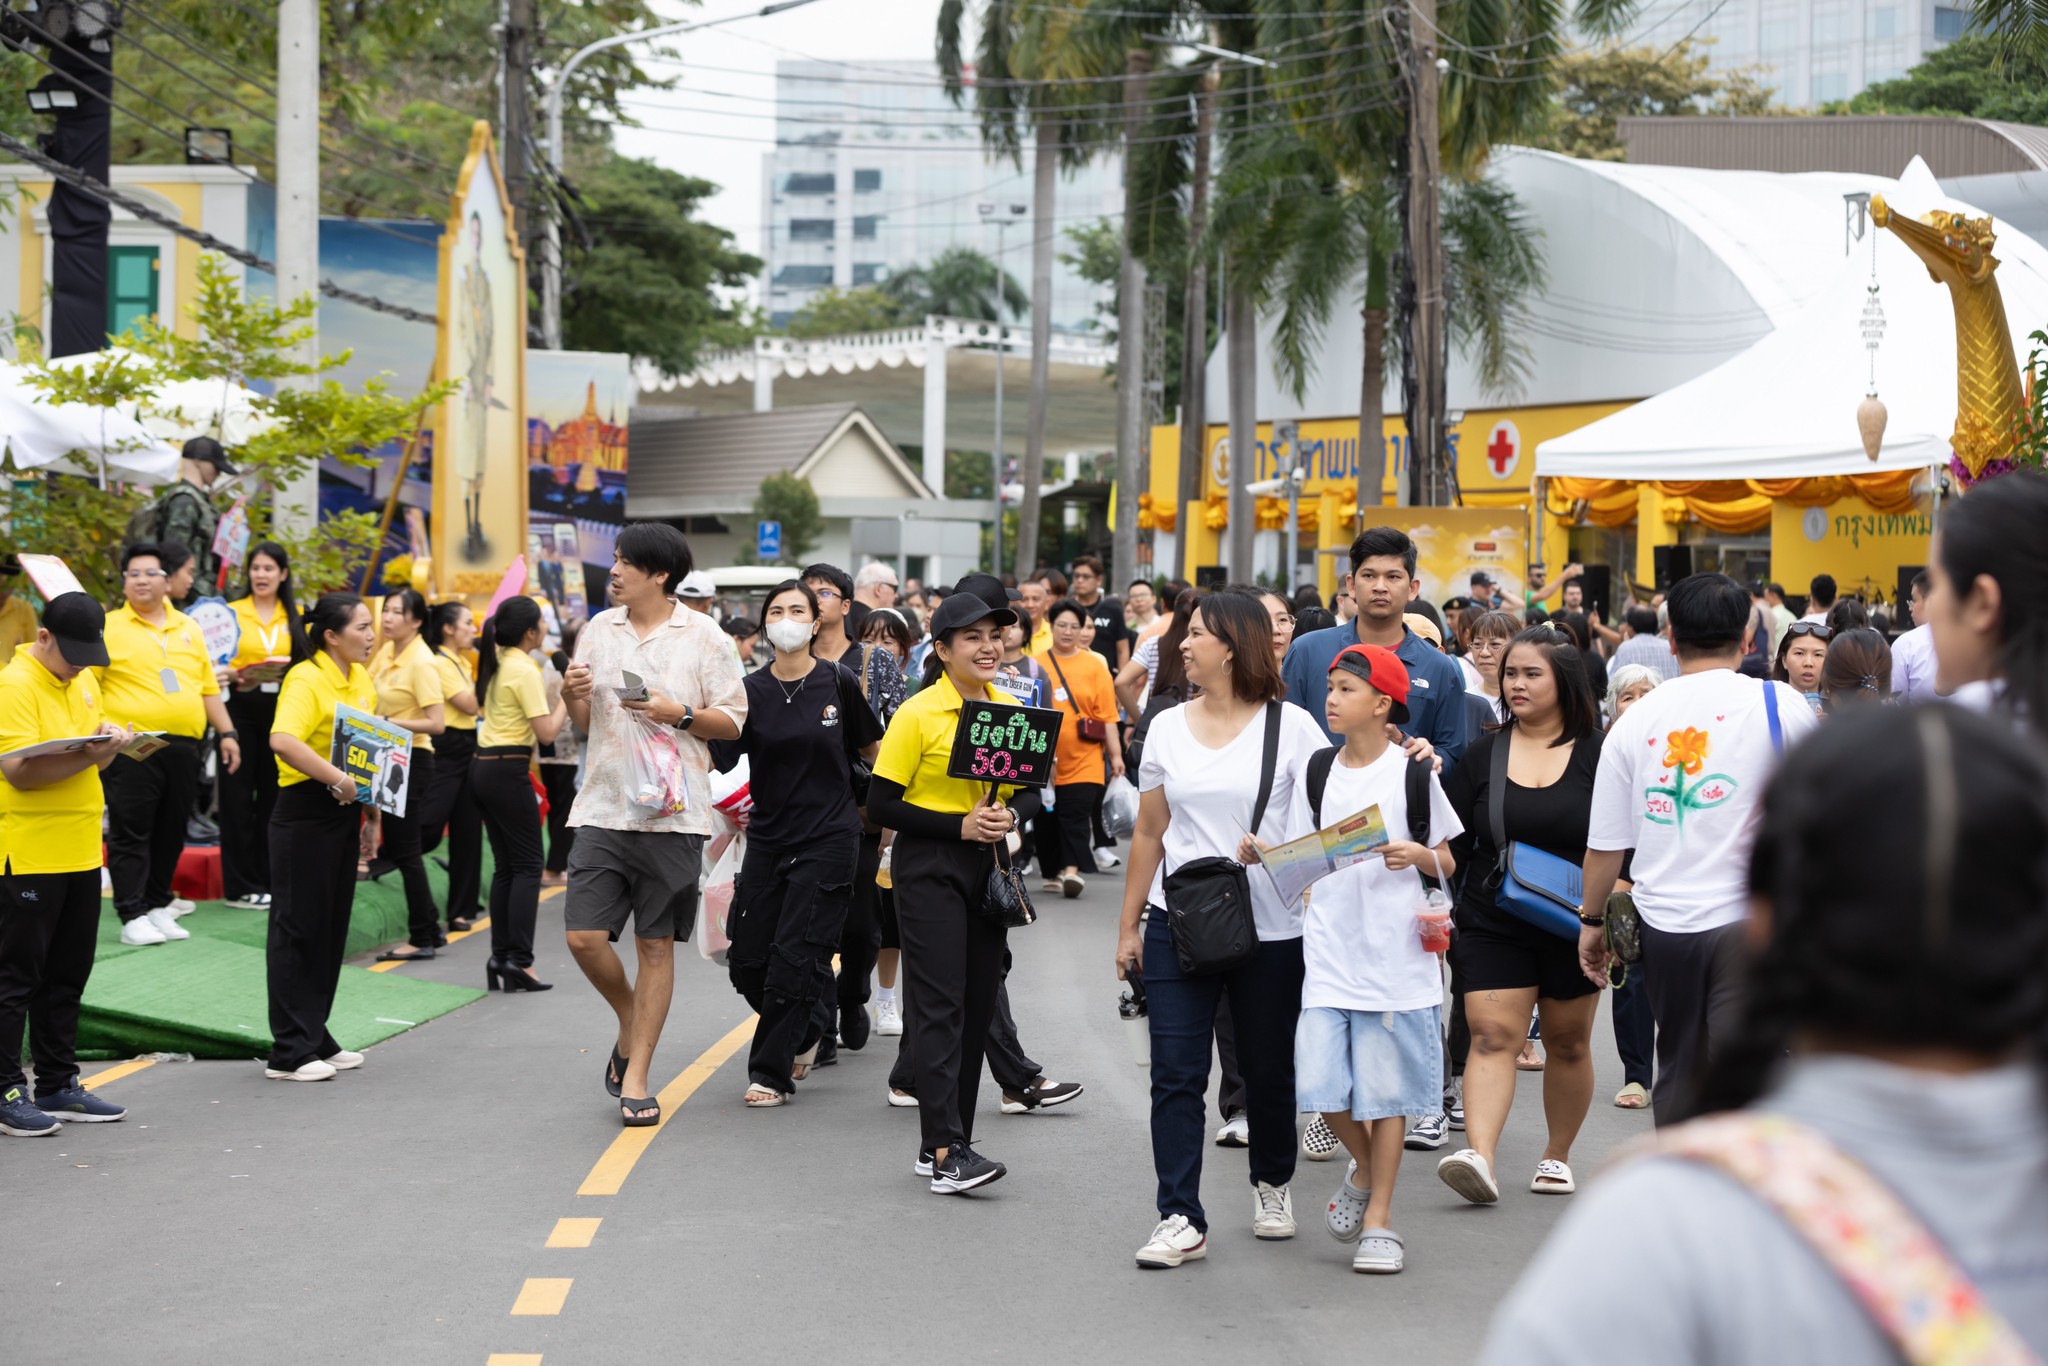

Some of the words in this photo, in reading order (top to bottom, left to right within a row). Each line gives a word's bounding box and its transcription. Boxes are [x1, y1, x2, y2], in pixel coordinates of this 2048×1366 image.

[970, 710, 1047, 753] ยิงปืน
[347, 745, 368, 769] 50
[971, 748, 1033, 778] 50.-
